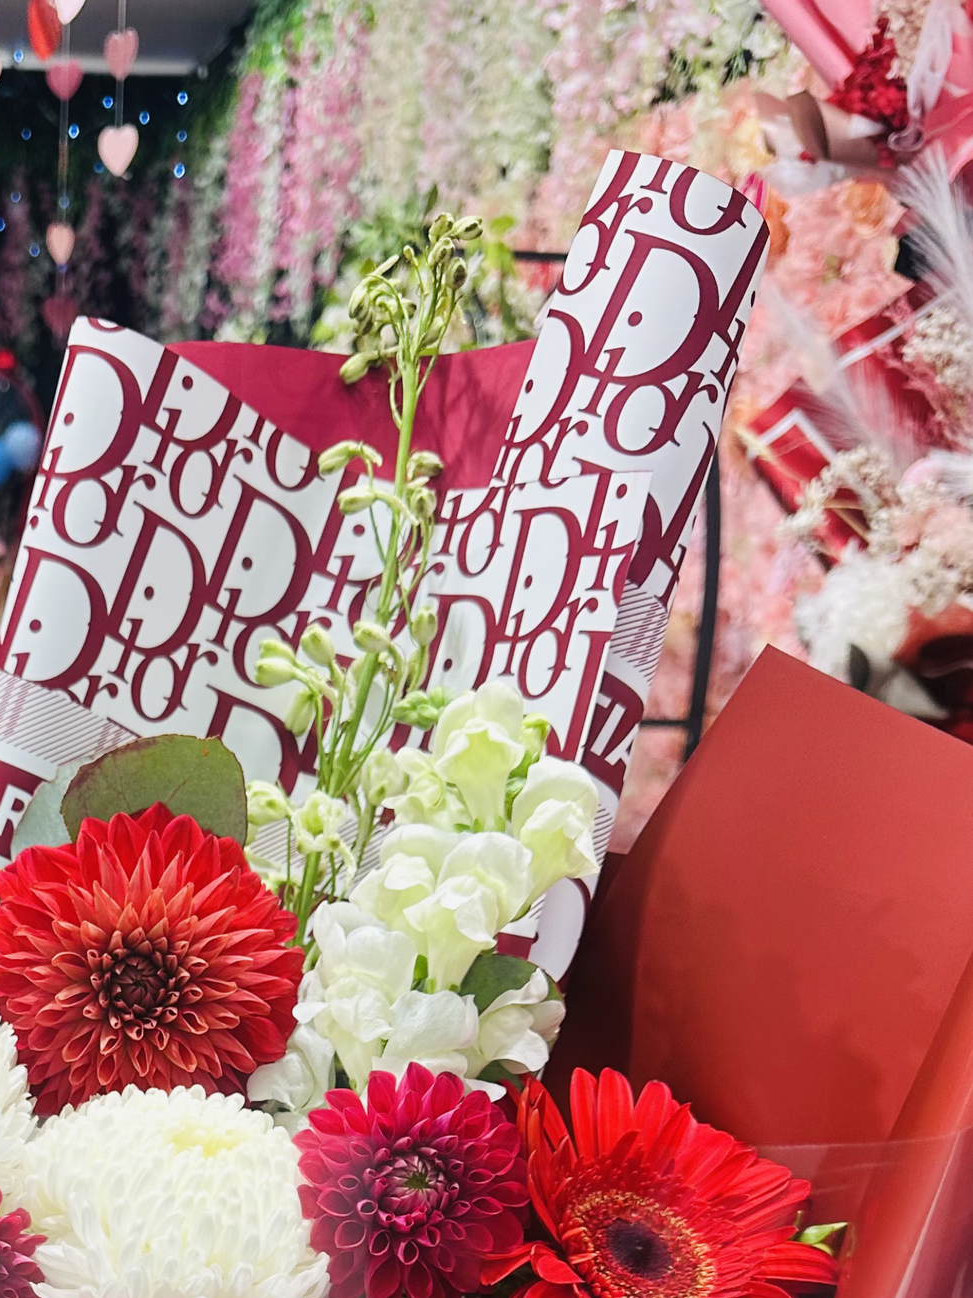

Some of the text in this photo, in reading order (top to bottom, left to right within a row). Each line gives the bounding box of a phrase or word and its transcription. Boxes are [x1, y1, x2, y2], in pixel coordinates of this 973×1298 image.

[33, 344, 156, 548] Dior
[578, 229, 720, 456] Dior
[107, 501, 219, 723] Dior
[498, 506, 599, 699] Dior
